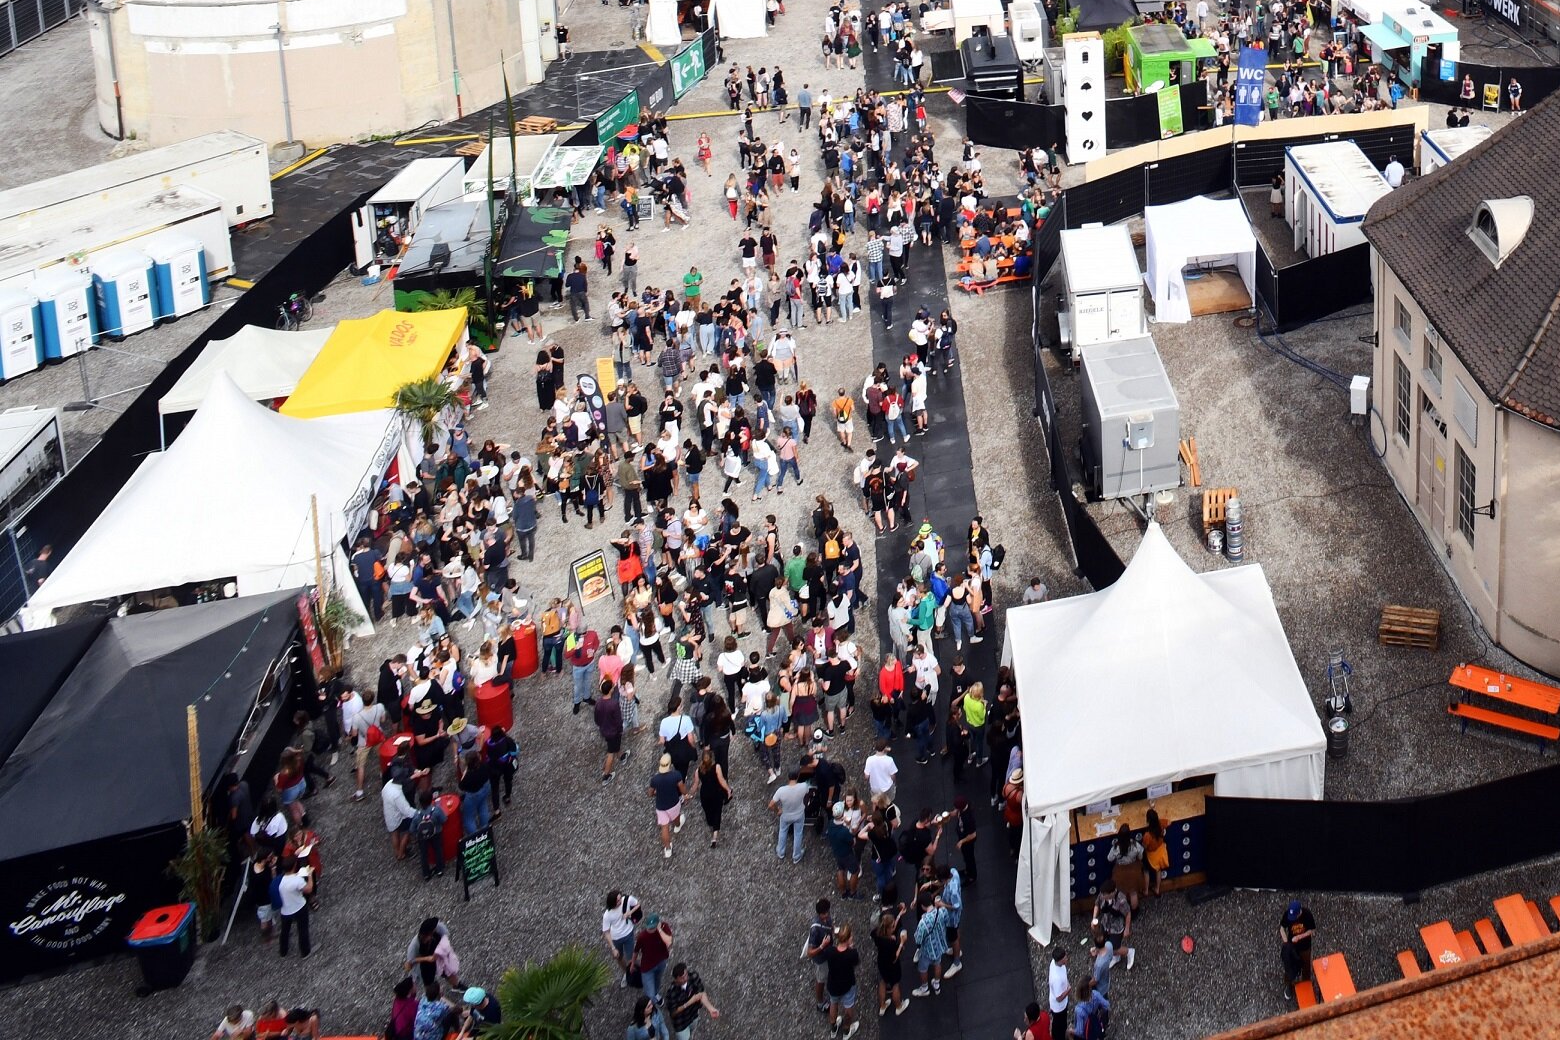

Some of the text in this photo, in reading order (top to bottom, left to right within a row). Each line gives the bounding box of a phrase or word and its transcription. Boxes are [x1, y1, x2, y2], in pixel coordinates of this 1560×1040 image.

[1239, 67, 1264, 81] WC
[26, 877, 108, 908] MAKE FOOD NOT WAR
[40, 890, 82, 916] Mr.
[8, 892, 127, 936] Camouflage
